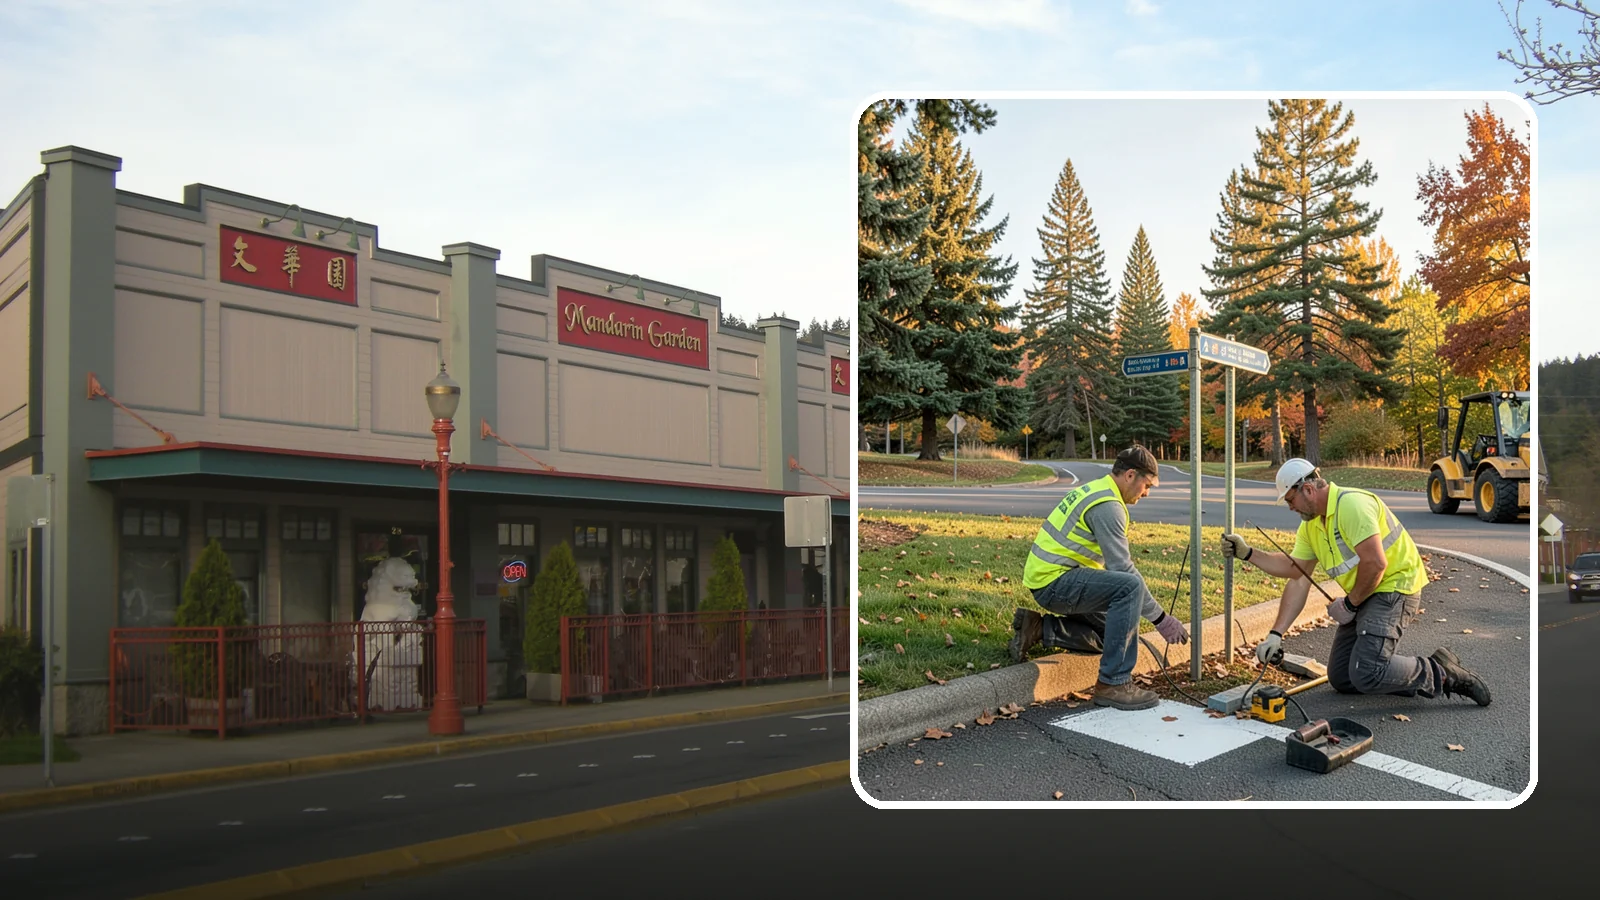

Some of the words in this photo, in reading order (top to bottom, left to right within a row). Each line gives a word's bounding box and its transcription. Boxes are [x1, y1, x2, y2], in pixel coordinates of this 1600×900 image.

[564, 302, 644, 341] Mandarin
[647, 320, 701, 352] Garden
[503, 565, 527, 578] OPEN
